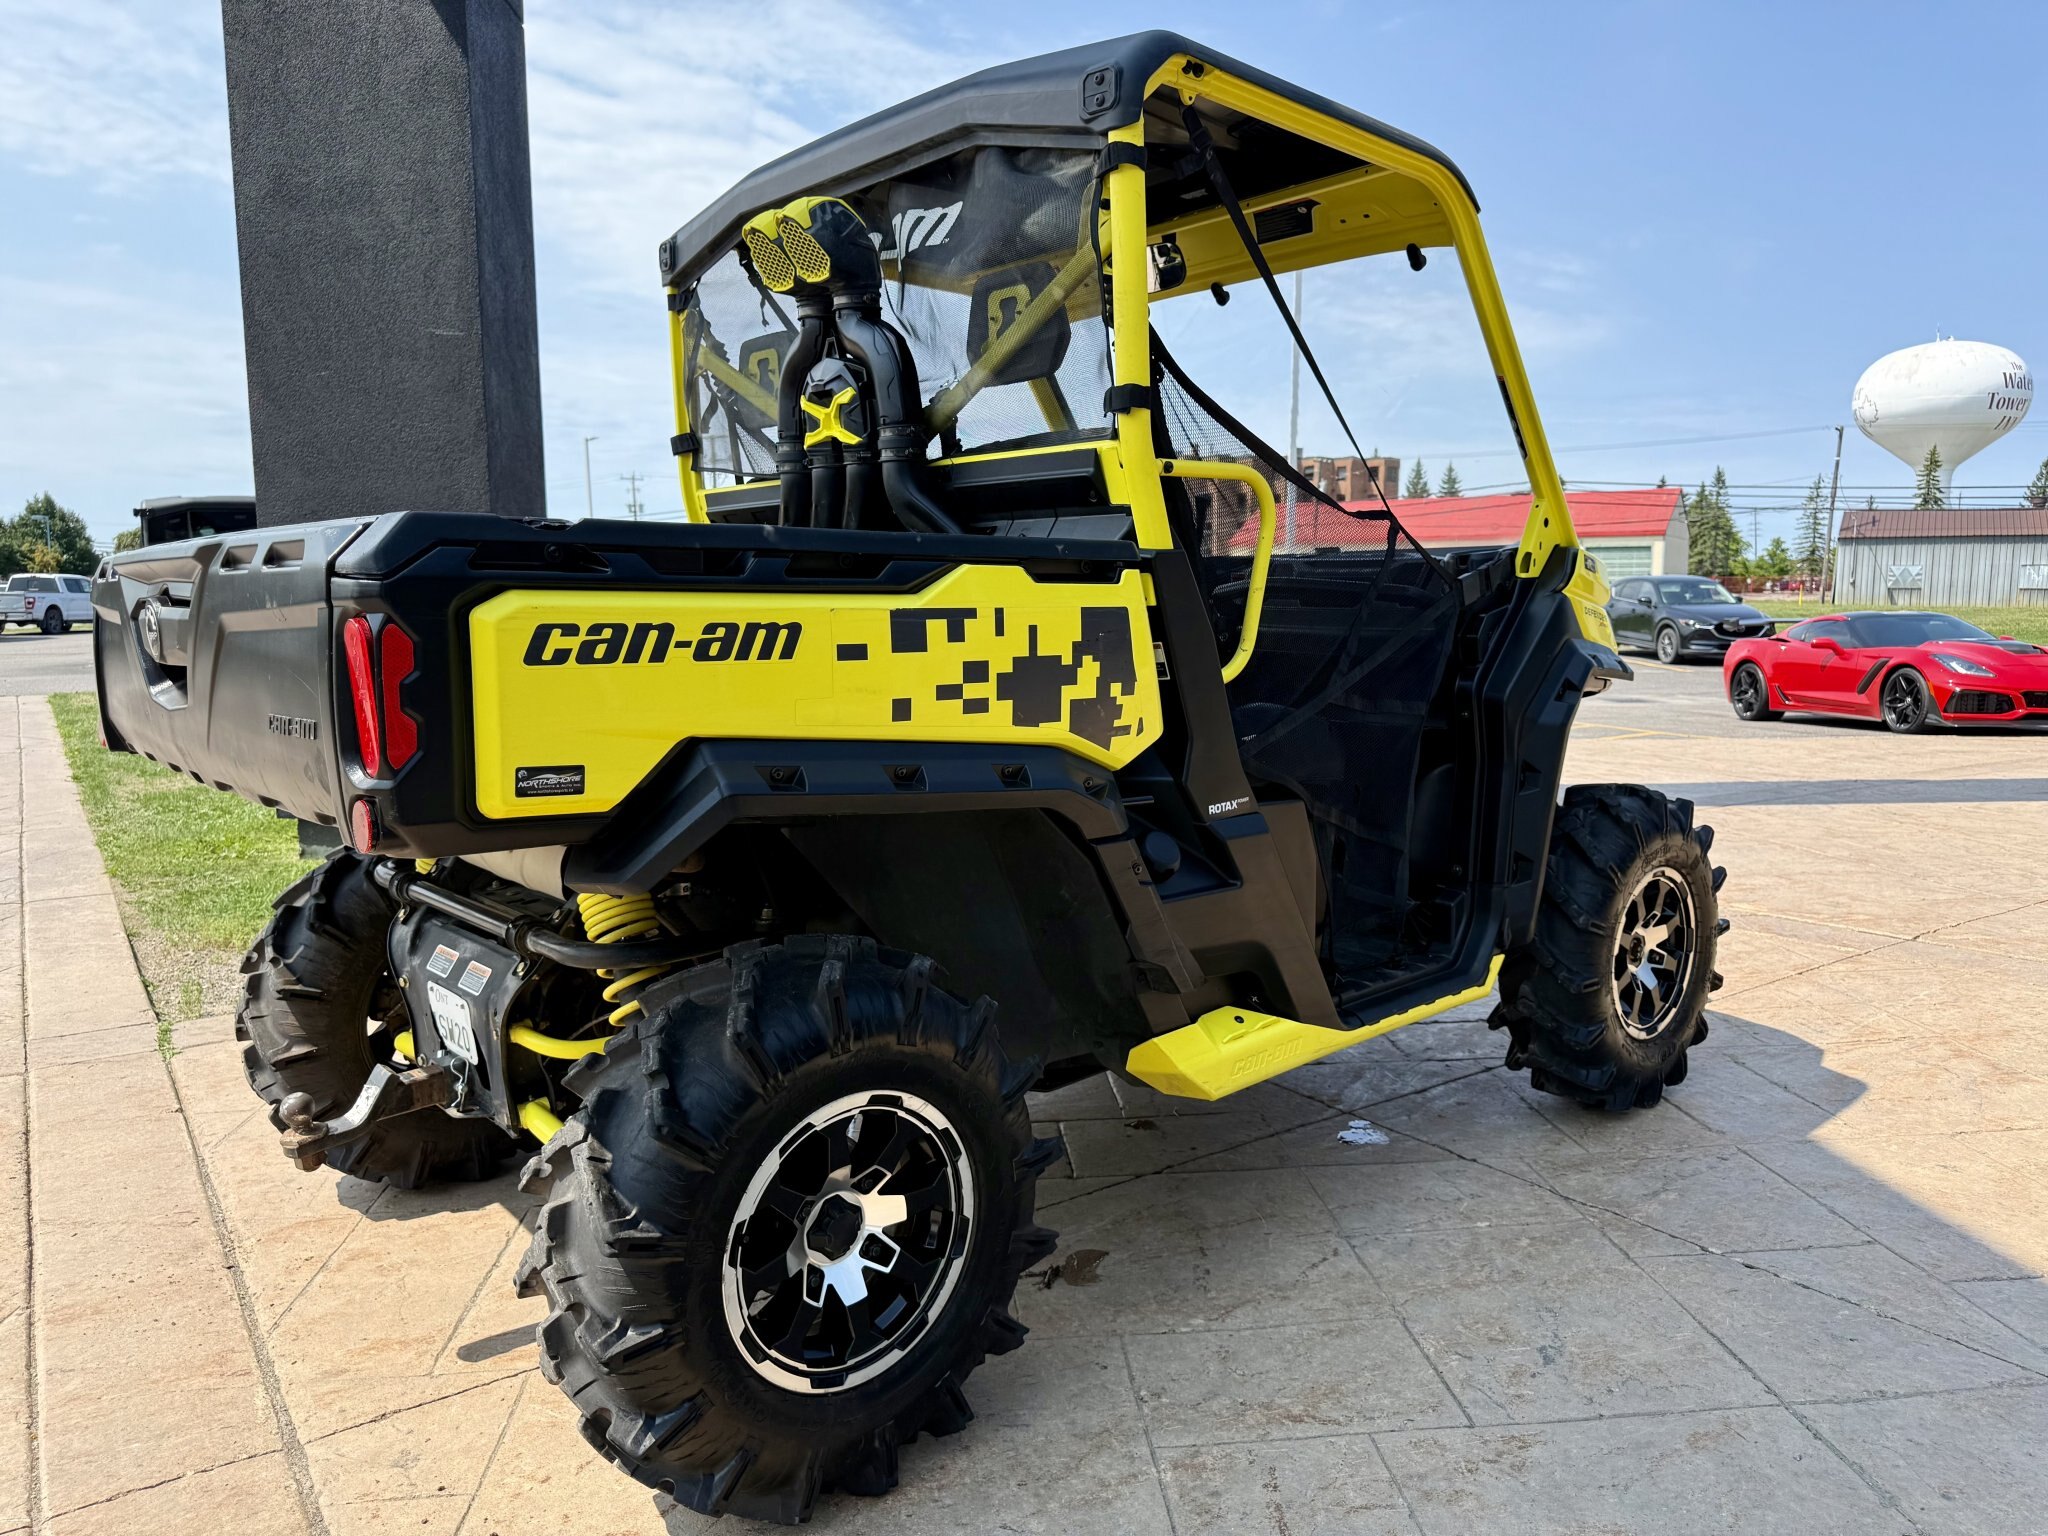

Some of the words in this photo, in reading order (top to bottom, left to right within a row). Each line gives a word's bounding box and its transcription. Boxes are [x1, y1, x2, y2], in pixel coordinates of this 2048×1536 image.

[1987, 391, 2029, 412] Tower
[523, 621, 803, 667] can-am
[517, 775, 583, 789] NORTHSHORE
[1208, 799, 1238, 815] ROTAX
